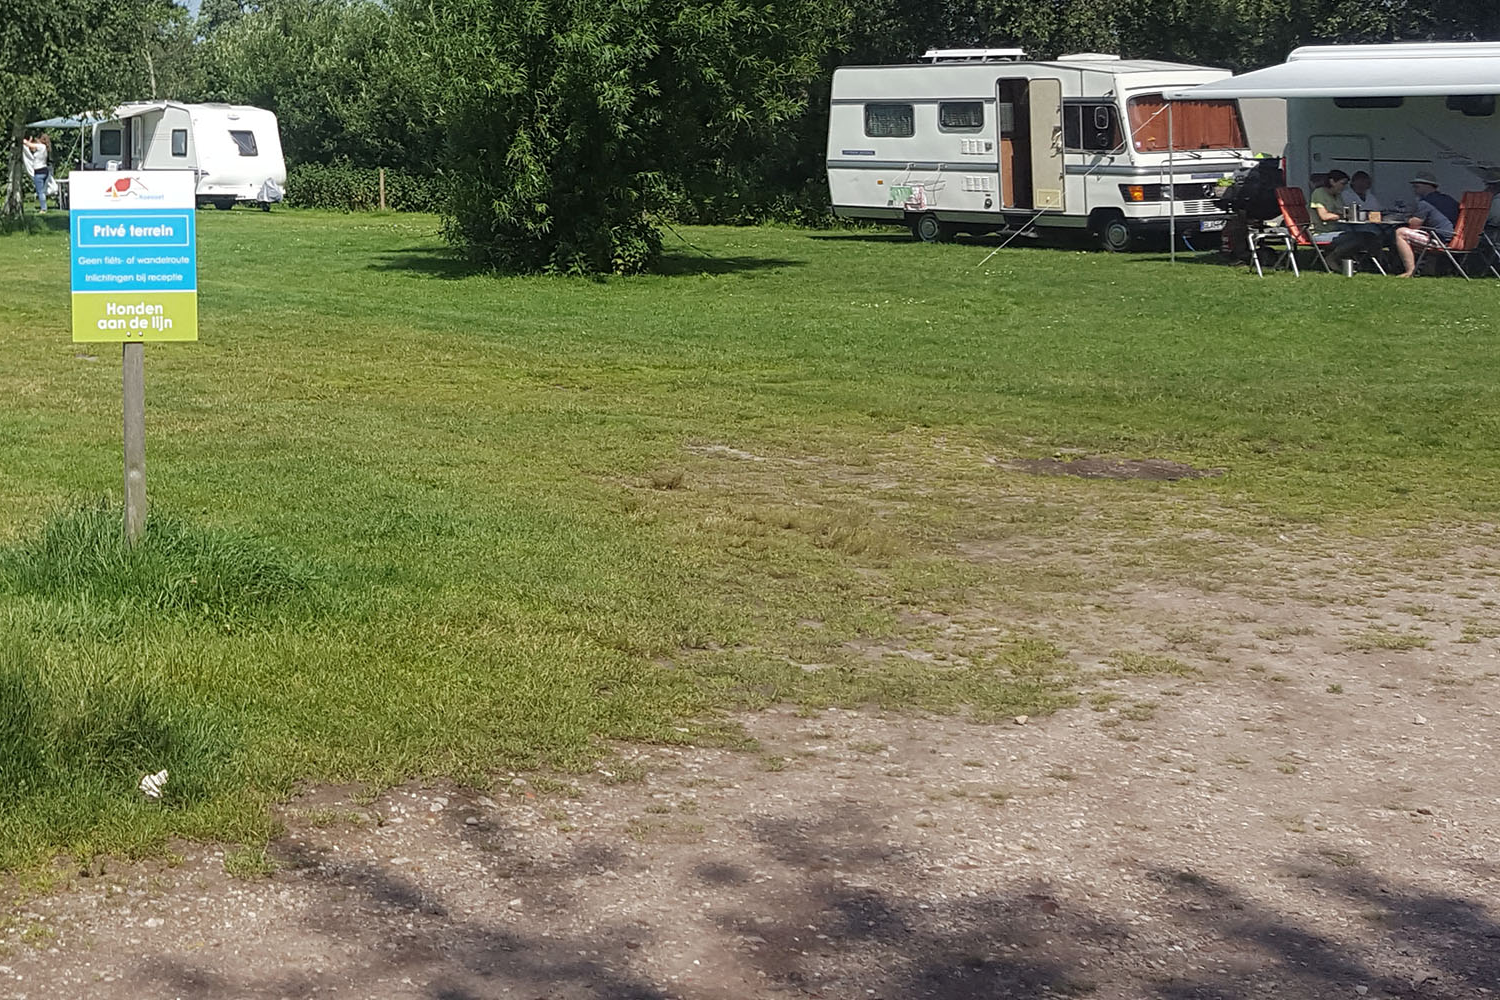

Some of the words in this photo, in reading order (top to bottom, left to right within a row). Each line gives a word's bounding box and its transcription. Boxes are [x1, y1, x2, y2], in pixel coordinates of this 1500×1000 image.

[93, 223, 126, 237] Privé
[129, 223, 174, 237] terrein
[78, 256, 103, 265] Geen
[126, 255, 135, 265] of
[137, 255, 189, 265] wandelroute
[85, 273, 134, 284] Inlichtingen
[135, 273, 147, 283] bij
[147, 273, 183, 283] receptie
[106, 301, 164, 315] Honden
[97, 318, 127, 330] aan
[129, 316, 149, 329] de
[151, 315, 173, 332] lijn
